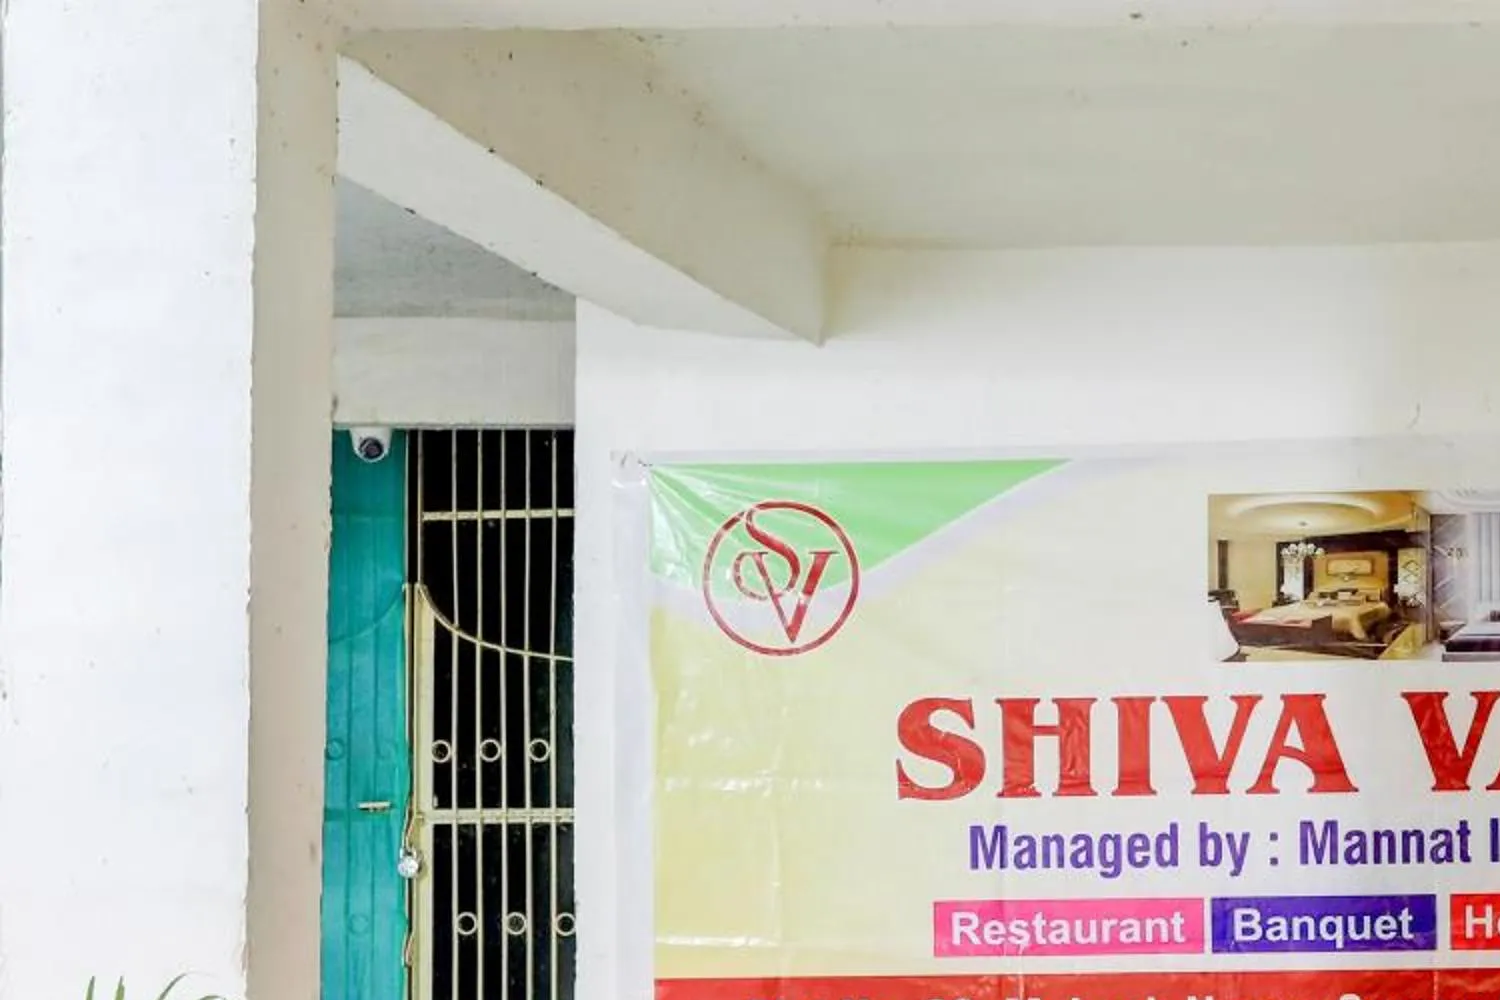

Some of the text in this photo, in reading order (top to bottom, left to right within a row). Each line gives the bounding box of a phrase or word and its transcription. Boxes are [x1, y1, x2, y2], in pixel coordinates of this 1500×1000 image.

[896, 694, 1359, 800] SHIVA
[969, 823, 1180, 879] Managed
[1198, 821, 1250, 877] by
[1299, 819, 1472, 867] Mannat
[950, 910, 1185, 946] Restaurant
[1234, 907, 1414, 951] Banquet
